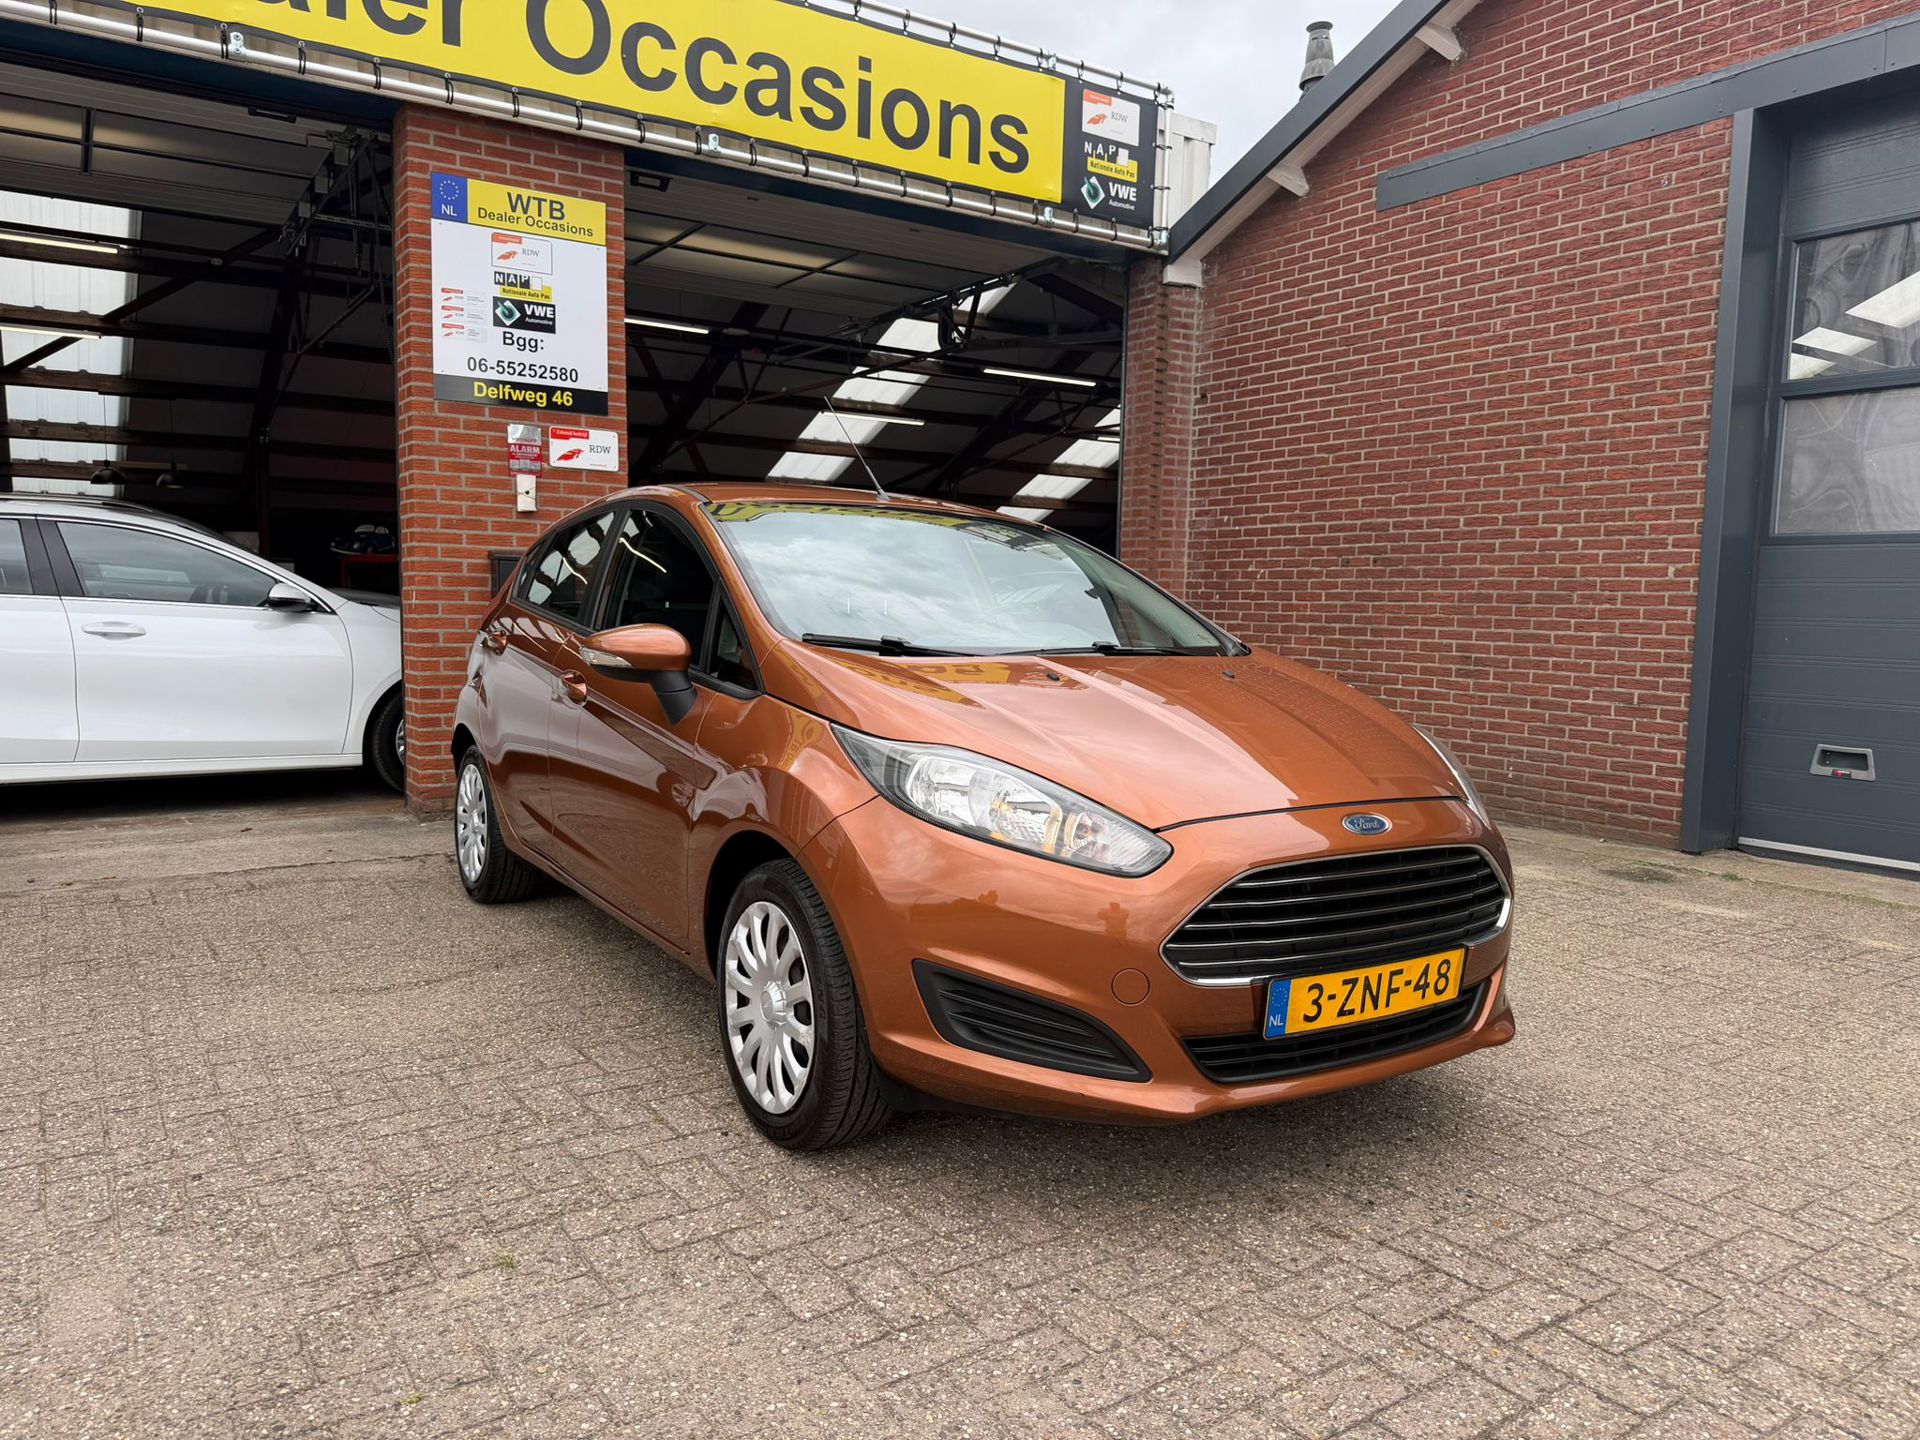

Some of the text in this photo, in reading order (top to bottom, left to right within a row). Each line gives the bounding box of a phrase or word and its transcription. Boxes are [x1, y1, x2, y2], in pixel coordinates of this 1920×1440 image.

[525, 0, 1029, 174] Occasions
[1090, 160, 1113, 173] Nationale
[1114, 166, 1126, 176] Auto
[1108, 182, 1137, 202] VWE
[441, 204, 457, 217] NL
[507, 192, 566, 221] WTB
[1108, 199, 1135, 211] Automotive
[478, 207, 593, 237] Dealer Occasions
[522, 248, 540, 257] RDW
[502, 287, 526, 297] Nationale
[528, 290, 540, 298] Auto
[524, 303, 555, 318] VWE
[525, 317, 553, 326] Automotive
[502, 331, 545, 353] Bgg:
[467, 356, 579, 383] 06-55252580
[473, 381, 573, 407] Delfweg 46
[510, 444, 540, 454] ALARM
[589, 444, 611, 454] RDW
[1353, 818, 1380, 830] Ford
[1303, 958, 1451, 1023] 3-ZNF-48
[1268, 1014, 1284, 1027] NL
